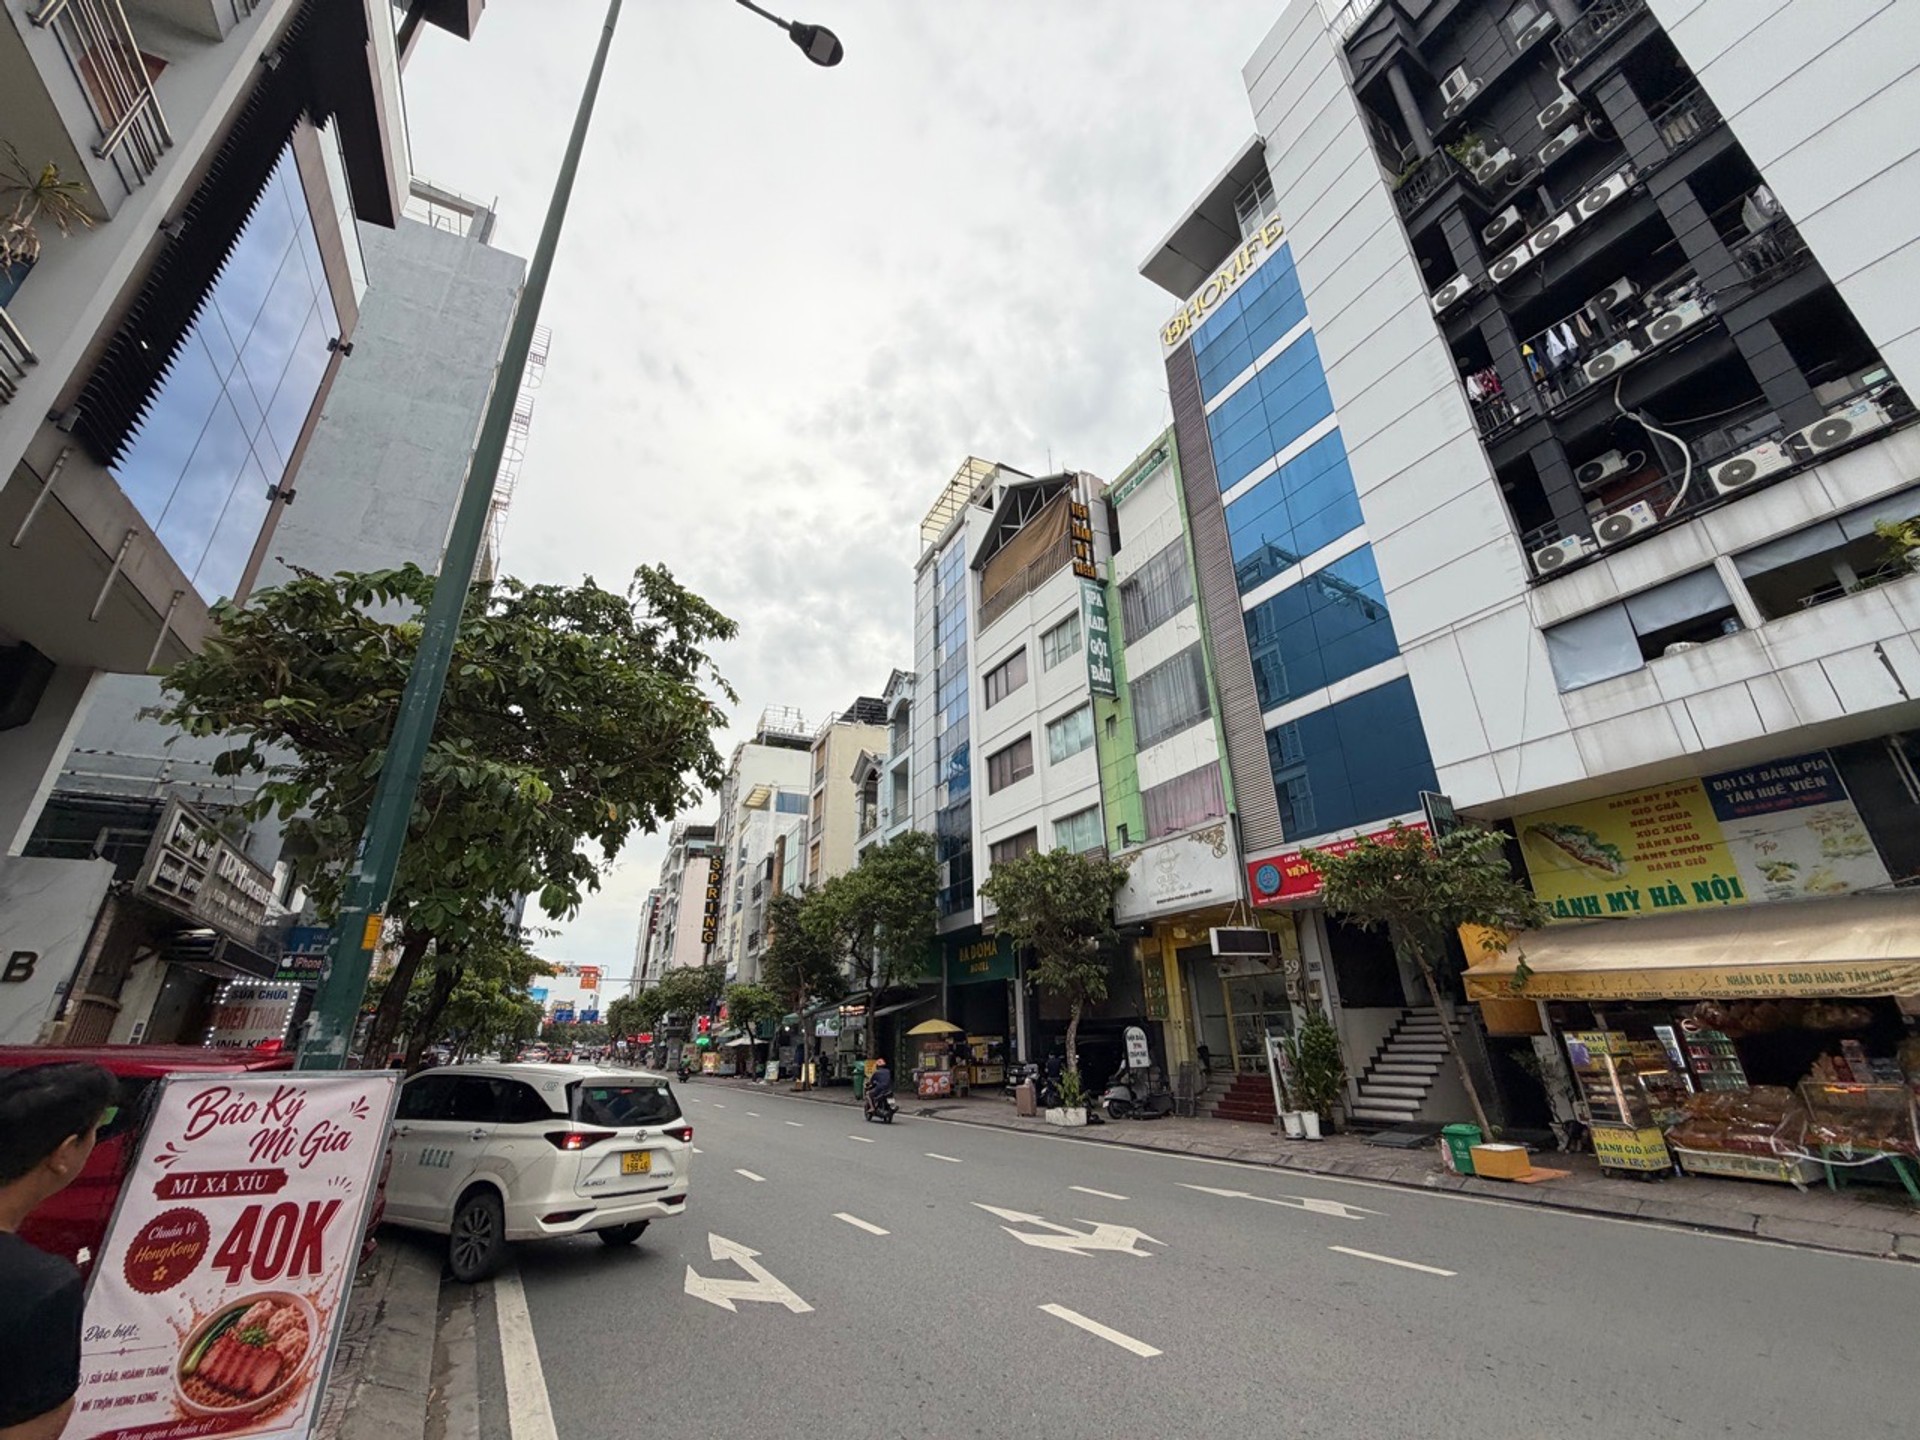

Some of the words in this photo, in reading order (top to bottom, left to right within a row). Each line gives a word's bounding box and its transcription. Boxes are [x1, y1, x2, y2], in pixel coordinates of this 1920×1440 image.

[1085, 589, 1104, 608] SPA
[1090, 637, 1109, 660] GỘI
[1739, 774, 1755, 787] LÝ
[1759, 764, 1800, 781] BÁNH
[1629, 817, 1656, 828] NEM
[1636, 827, 1660, 839] XÚC
[1636, 838, 1672, 850] BÁNH
[1674, 833, 1701, 844] BAO
[1633, 850, 1668, 862] BÁNH
[1646, 859, 1682, 873] BÁNH
[703, 859, 722, 943] SPRING
[1648, 878, 1688, 908] HÀ
[1691, 873, 1744, 906] NỘI
[1, 950, 39, 983] B
[1283, 959, 1300, 975] 59
[1725, 973, 1753, 988] NHẬN
[1778, 973, 1786, 985] &
[1788, 972, 1814, 985] GIAO
[1815, 969, 1846, 984] HÀNG
[184, 1086, 259, 1142] Bảo
[260, 1084, 309, 1129] Ký
[249, 1127, 301, 1165] Mì
[299, 1120, 354, 1168] Gia
[169, 1173, 199, 1197] MÌ
[201, 1171, 232, 1194] XÁ
[233, 1171, 270, 1192] XÍU
[133, 1240, 201, 1265] HongKong
[210, 1198, 343, 1286] 40K
[83, 1325, 111, 1343] Đặc
[114, 1394, 136, 1408] HONG
[136, 1391, 159, 1405] KONG
